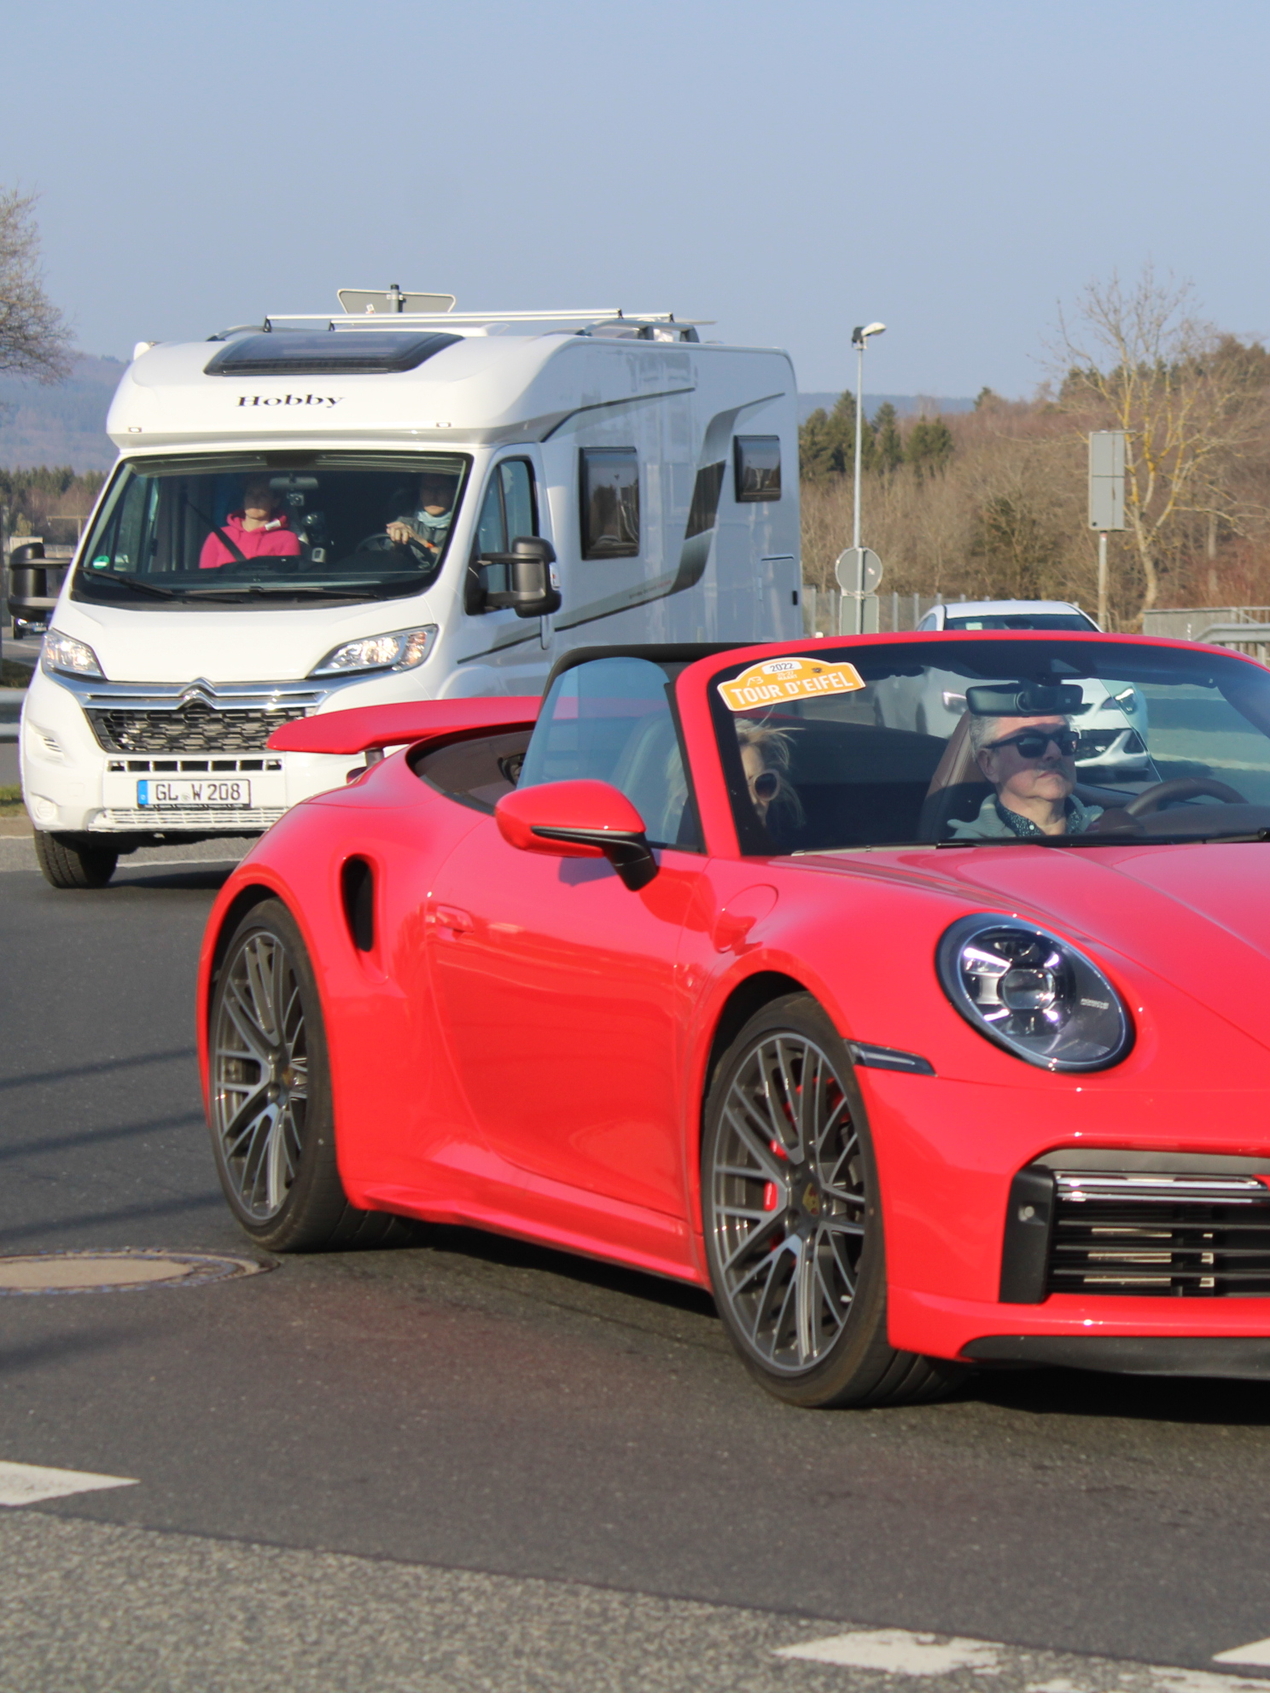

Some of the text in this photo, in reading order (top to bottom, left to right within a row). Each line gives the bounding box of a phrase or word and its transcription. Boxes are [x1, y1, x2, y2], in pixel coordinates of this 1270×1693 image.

[235, 394, 346, 408] Hobby
[769, 662, 795, 673] 2022
[730, 671, 854, 706] TOUR D'EIFEL
[155, 783, 241, 801] GL W 208
